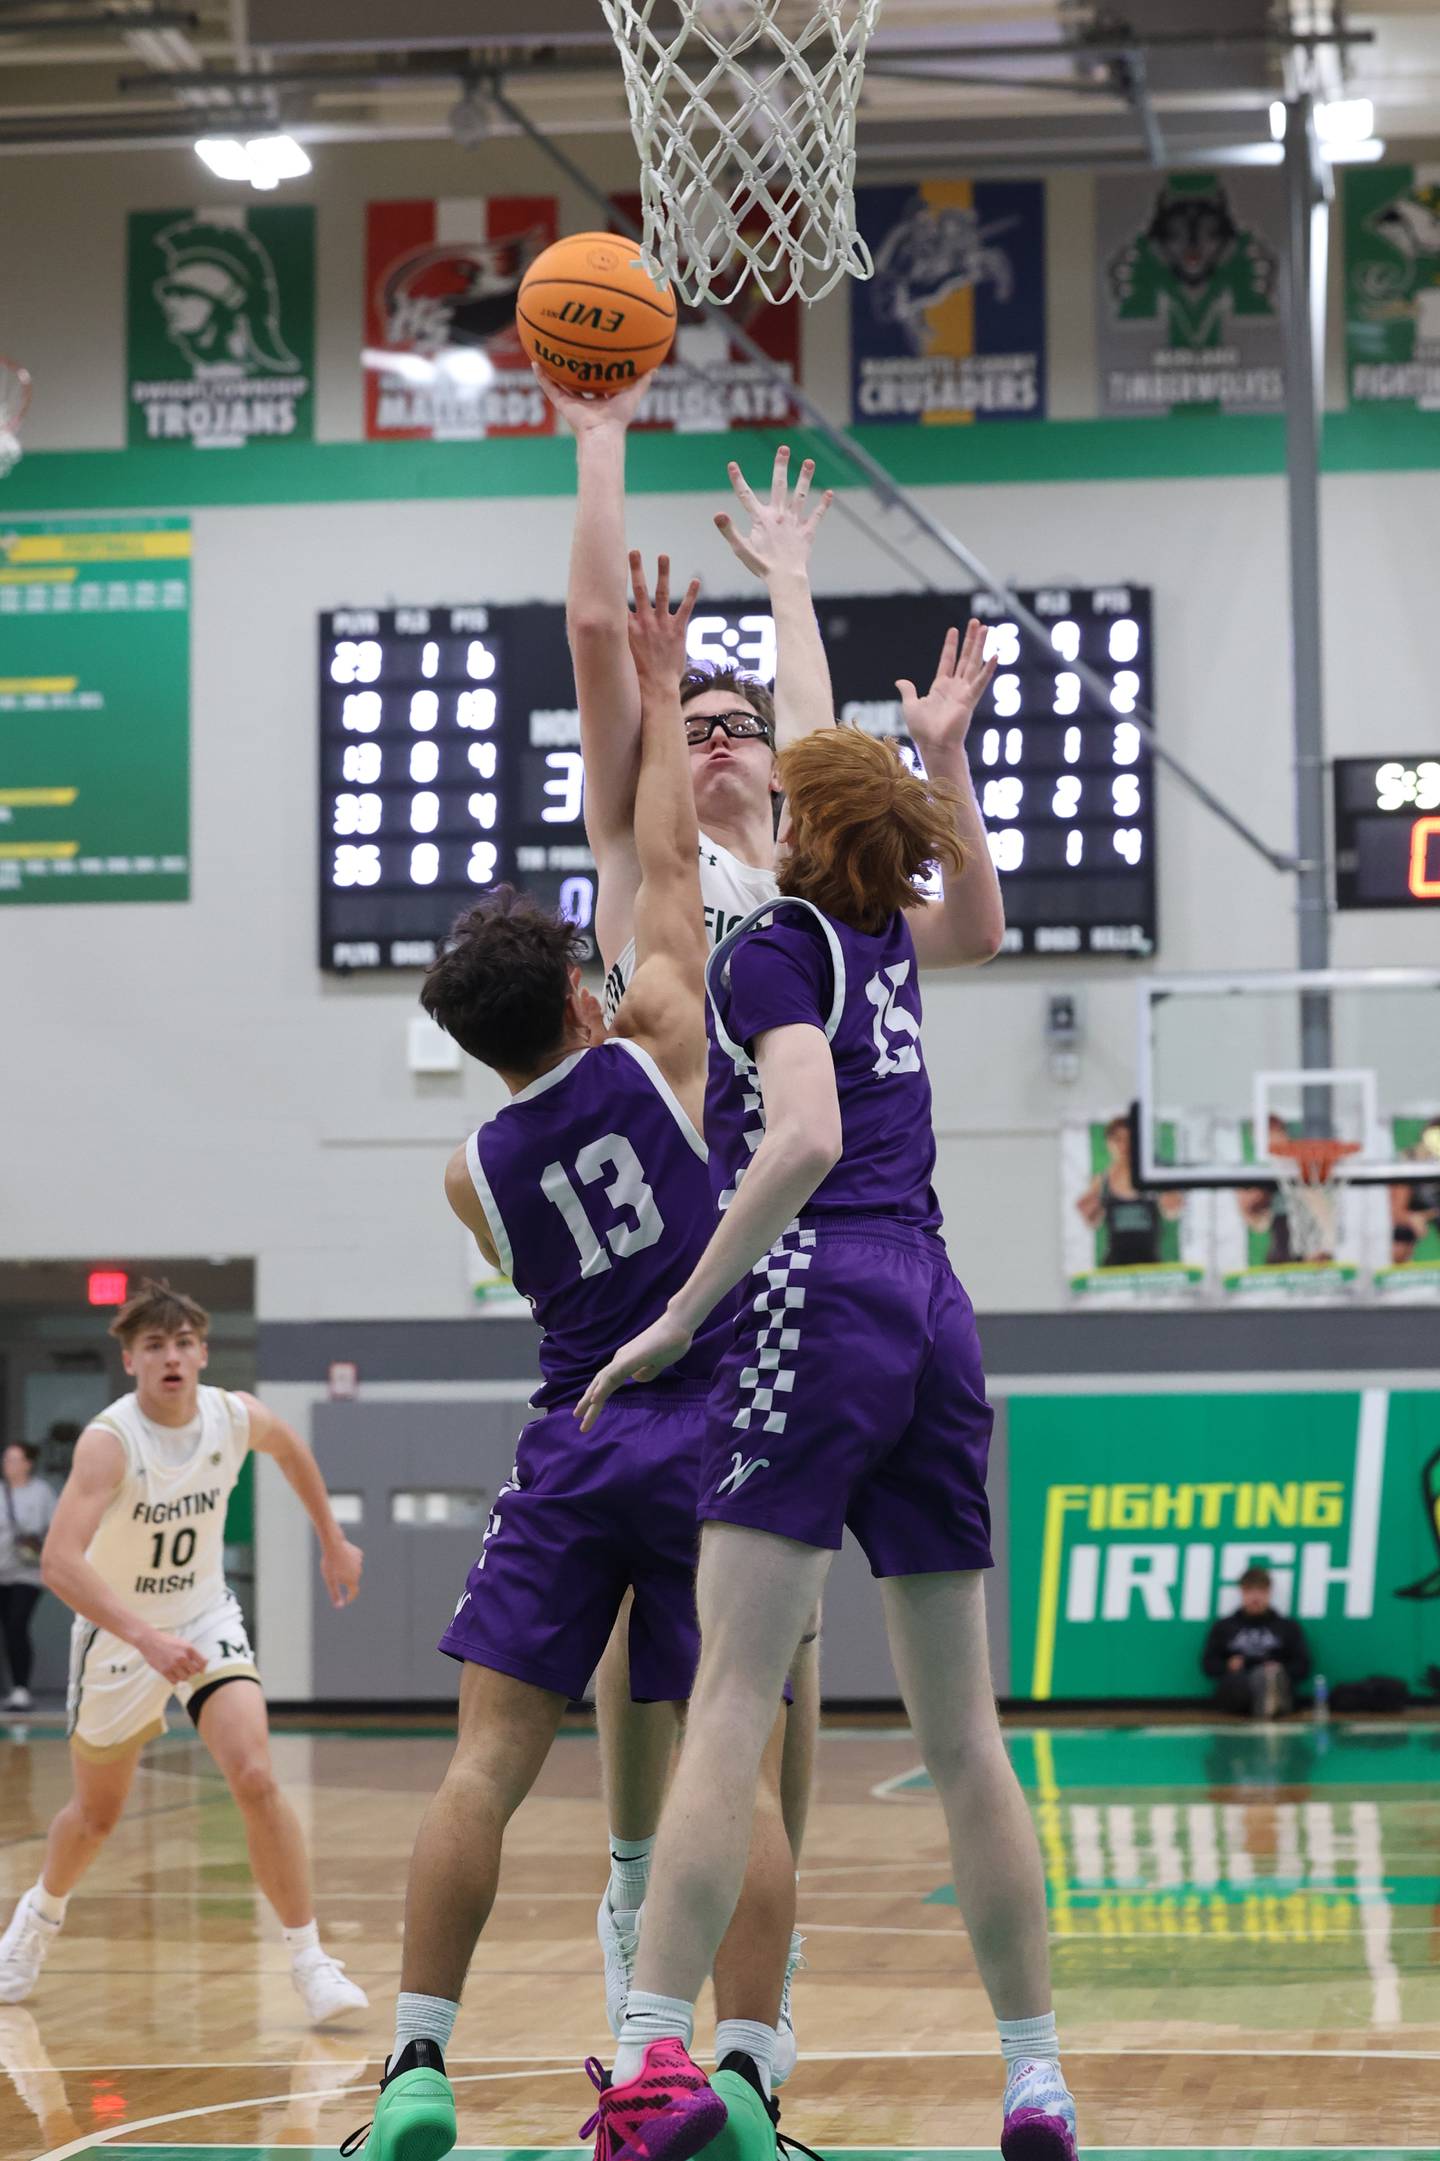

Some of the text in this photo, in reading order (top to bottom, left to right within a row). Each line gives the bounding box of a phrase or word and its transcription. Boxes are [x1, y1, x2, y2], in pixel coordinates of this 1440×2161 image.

[559, 301, 625, 333] EVO
[533, 339, 637, 382] Wilson
[858, 376, 1038, 414] CRUSADERS
[145, 400, 296, 438] TROJANS
[421, 641, 440, 679] 1
[1052, 671, 1081, 715] 3
[982, 722, 1141, 765] 11 1 3
[541, 752, 584, 823] 3
[1052, 775, 1082, 818] 2
[1111, 774, 1141, 817] 5
[467, 792, 497, 829] 4
[467, 841, 498, 884] 2
[1066, 829, 1083, 867] 1
[1112, 828, 1142, 865] 4
[865, 959, 921, 1080] 15
[539, 1132, 665, 1281] 13
[132, 1488, 220, 1525] FIGHTIN'
[152, 1528, 197, 1570] 10
[134, 1572, 195, 1595] IRISH
